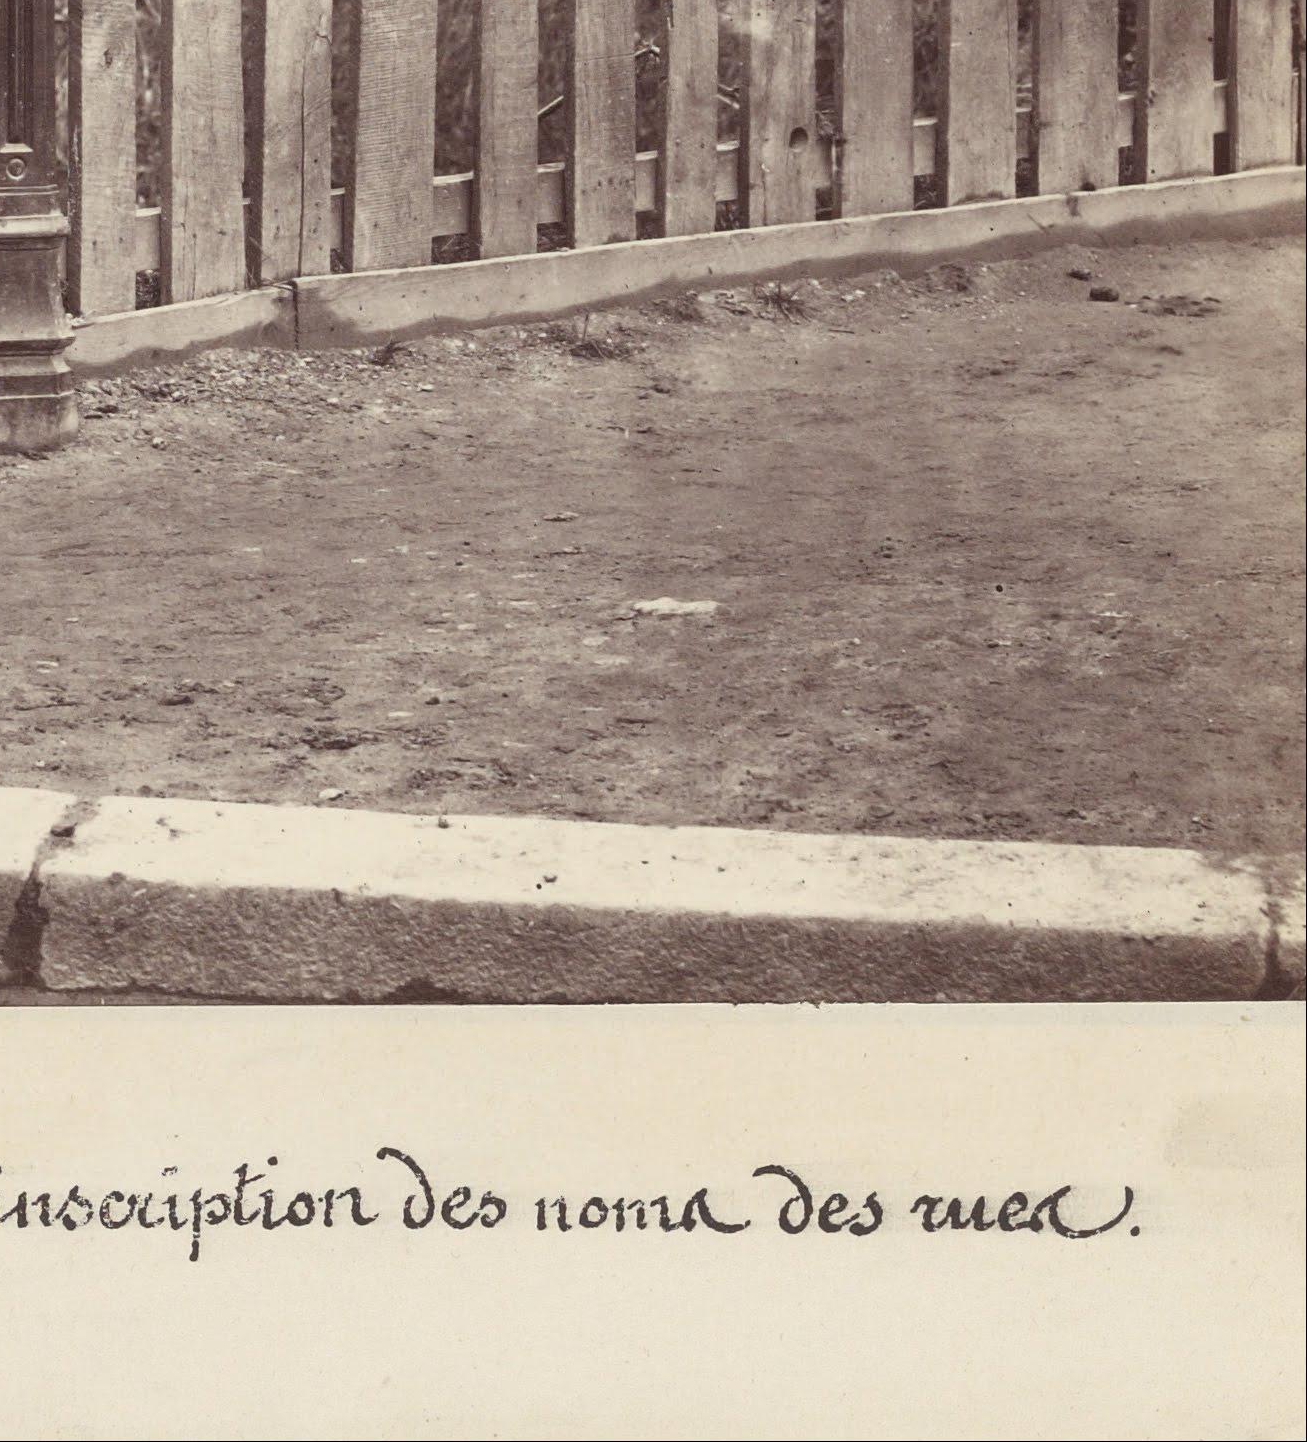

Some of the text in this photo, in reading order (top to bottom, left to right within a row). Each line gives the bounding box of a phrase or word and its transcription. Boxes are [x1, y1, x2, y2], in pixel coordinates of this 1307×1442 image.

[376, 1146, 507, 1230] des
[534, 1187, 751, 1234] noms
[752, 1164, 884, 1237] des
